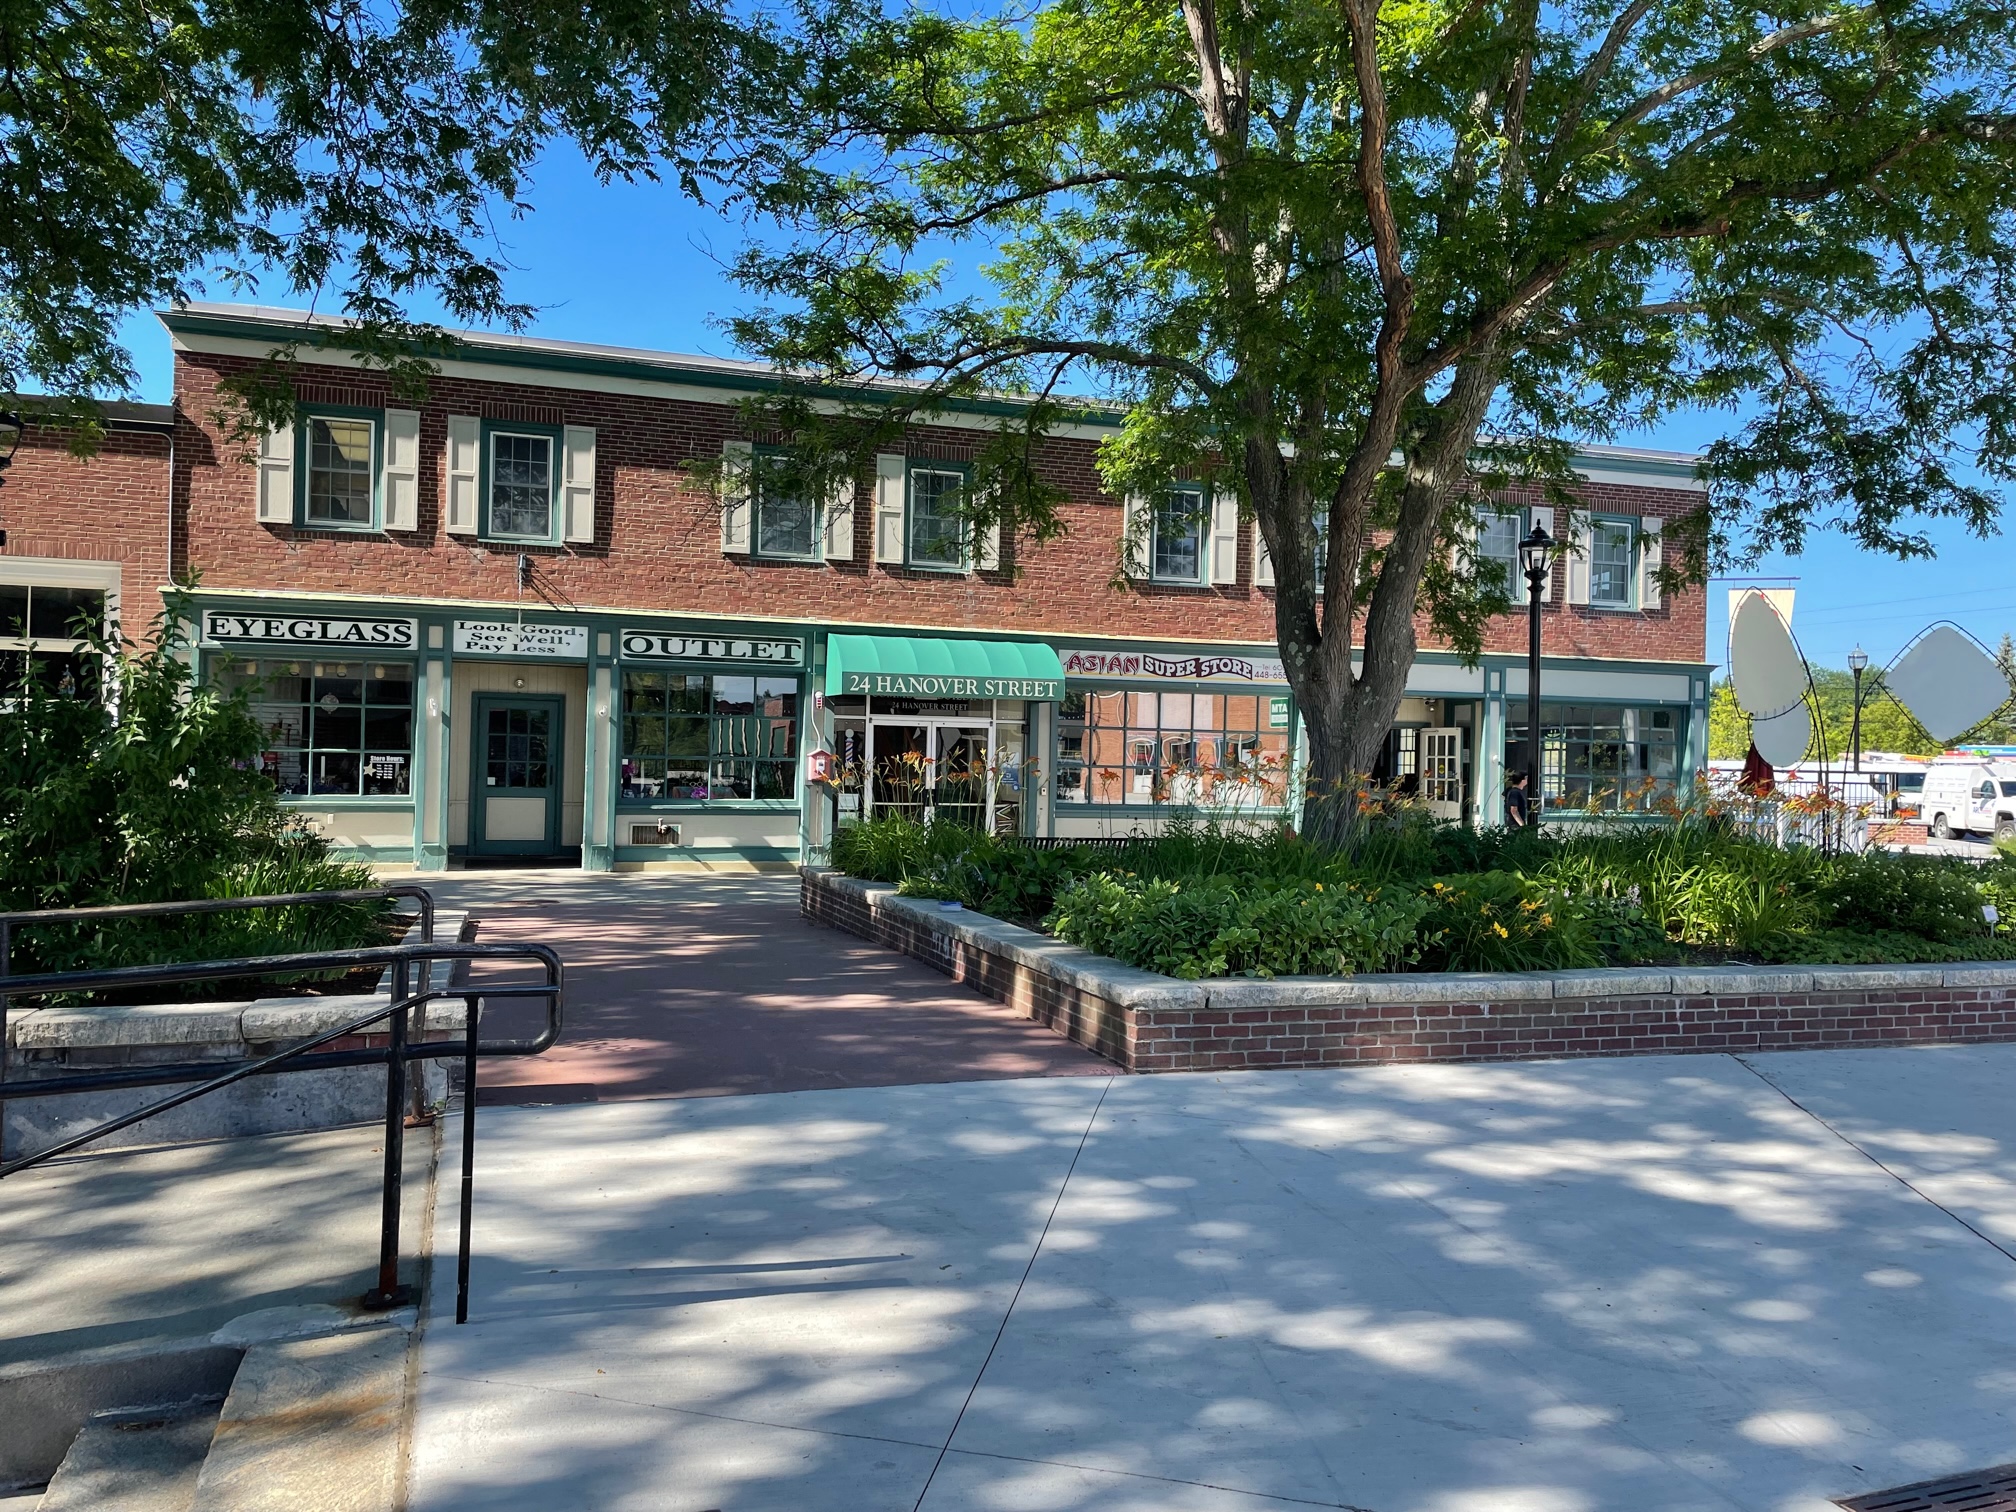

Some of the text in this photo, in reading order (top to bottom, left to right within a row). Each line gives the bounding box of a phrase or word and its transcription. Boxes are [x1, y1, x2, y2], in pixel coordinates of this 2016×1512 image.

[206, 617, 412, 643] EYEGLASS
[458, 622, 584, 637] Look Good,
[470, 632, 571, 646] See Well,
[465, 641, 556, 653] Pay Less
[622, 636, 802, 660] OUTLET
[1063, 651, 1251, 678] ASIAN SUPER STORE
[1254, 670, 1288, 679] 448-655
[849, 675, 1059, 697] 24 HANOVER STREET
[892, 701, 968, 711] 24 HANOVER STREET
[1271, 703, 1288, 713] MTA
